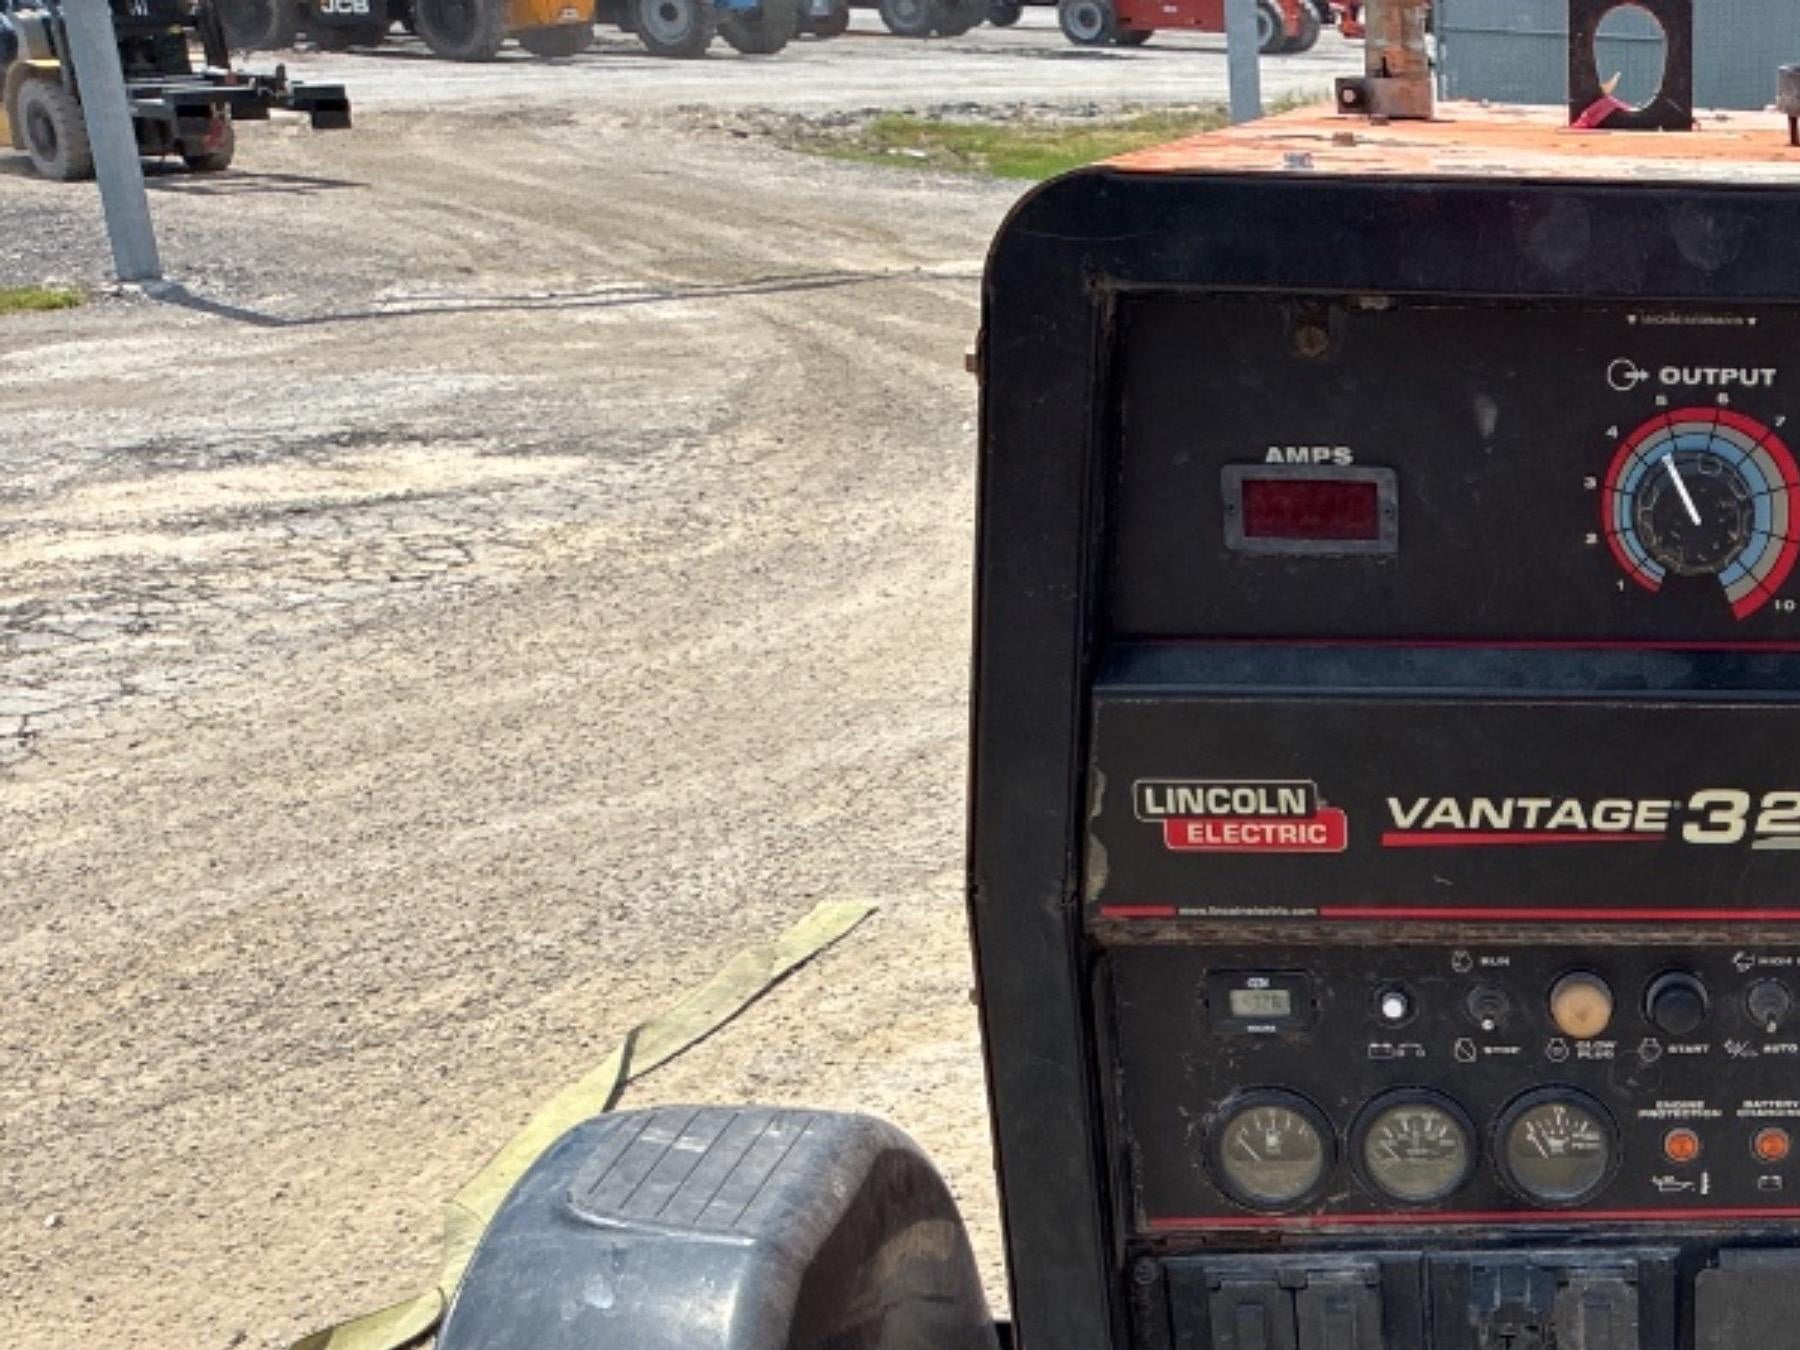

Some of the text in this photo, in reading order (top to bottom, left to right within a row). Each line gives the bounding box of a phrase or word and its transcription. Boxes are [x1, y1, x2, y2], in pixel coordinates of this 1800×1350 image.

[1658, 366, 1778, 387] OUTPUT
[1654, 394, 1669, 406] 5
[1716, 391, 1730, 404] 6
[1774, 415, 1787, 427] 7
[1604, 425, 1619, 439] 4
[1264, 446, 1354, 465] AMPS
[1583, 475, 1597, 490] 3
[1584, 532, 1598, 545] 2
[1616, 579, 1625, 592] 1
[1775, 599, 1796, 611] 10
[1144, 787, 1306, 815] LINCOLN
[1385, 797, 1671, 831] VANTAGE
[1186, 823, 1327, 845] ELECTRIC
